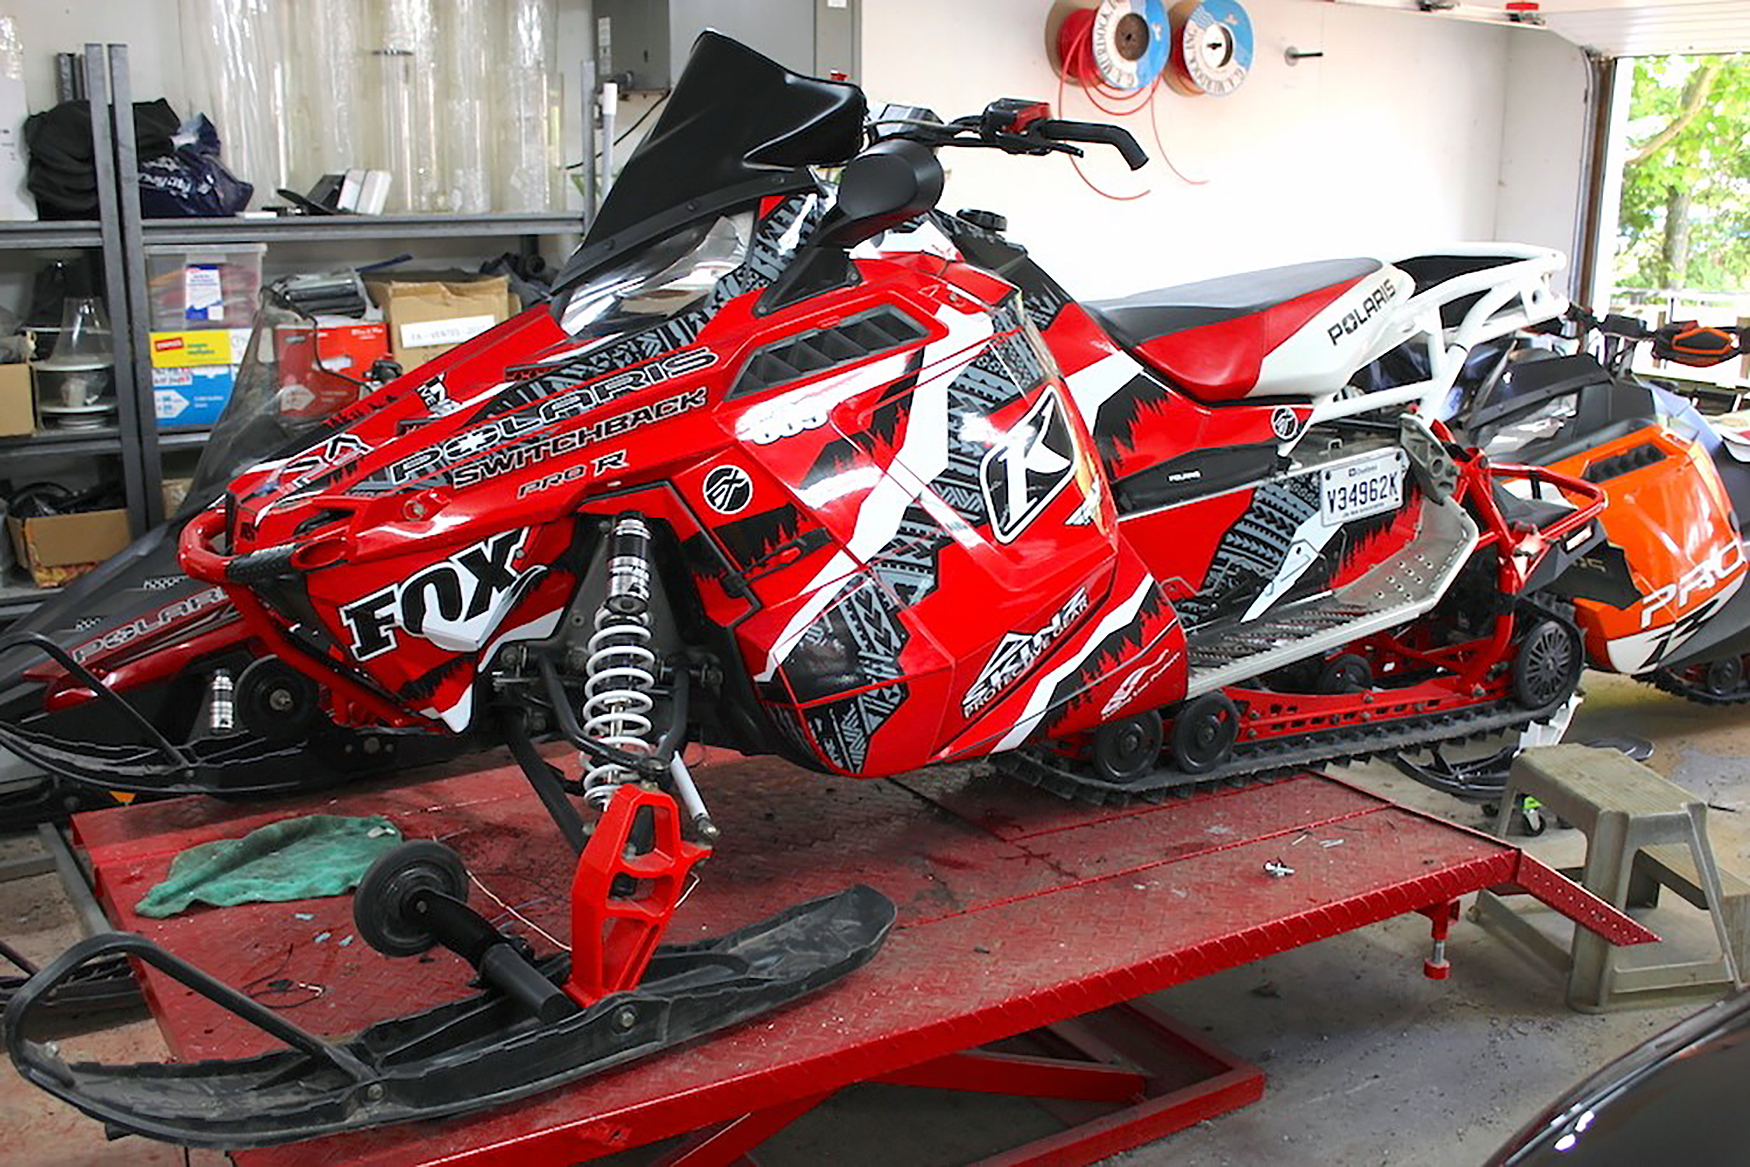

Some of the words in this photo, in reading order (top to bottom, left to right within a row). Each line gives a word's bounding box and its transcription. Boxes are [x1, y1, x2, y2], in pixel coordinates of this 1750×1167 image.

[1327, 278, 1396, 346] POLARIS
[390, 347, 718, 485] POLARIS
[452, 386, 708, 489] SWITCHBACK
[517, 464, 586, 499] PRO
[594, 449, 629, 477] R
[1327, 471, 1398, 514] V34962K
[338, 526, 532, 662] FOX
[1052, 597, 1089, 637] GEAR
[1641, 538, 1748, 629] PRO
[73, 586, 229, 664] POLAR
